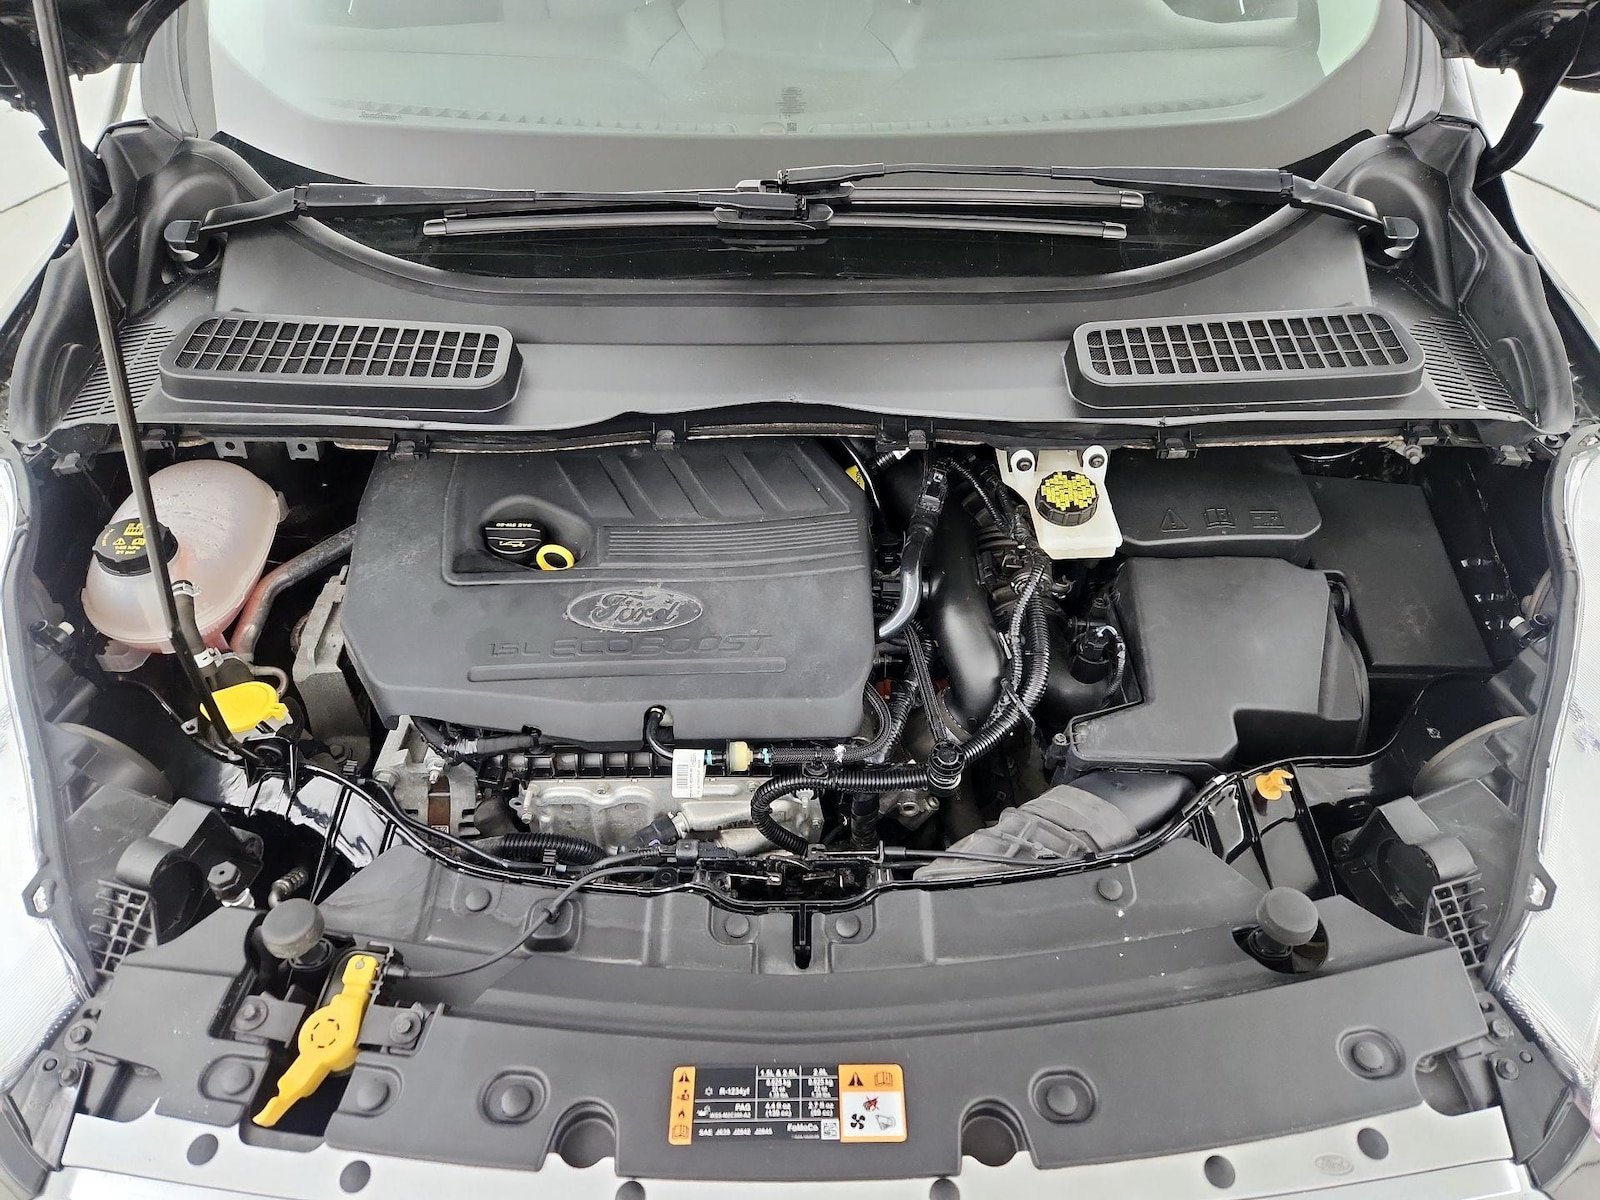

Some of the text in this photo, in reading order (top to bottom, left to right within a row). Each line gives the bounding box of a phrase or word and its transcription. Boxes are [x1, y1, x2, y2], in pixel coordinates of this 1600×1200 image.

[588, 592, 684, 625] Ford
[718, 1086, 750, 1097] R-1234yf
[734, 1102, 752, 1112] PAG
[786, 1122, 819, 1132] FoMoCo
[698, 1128, 714, 1137] SAE
